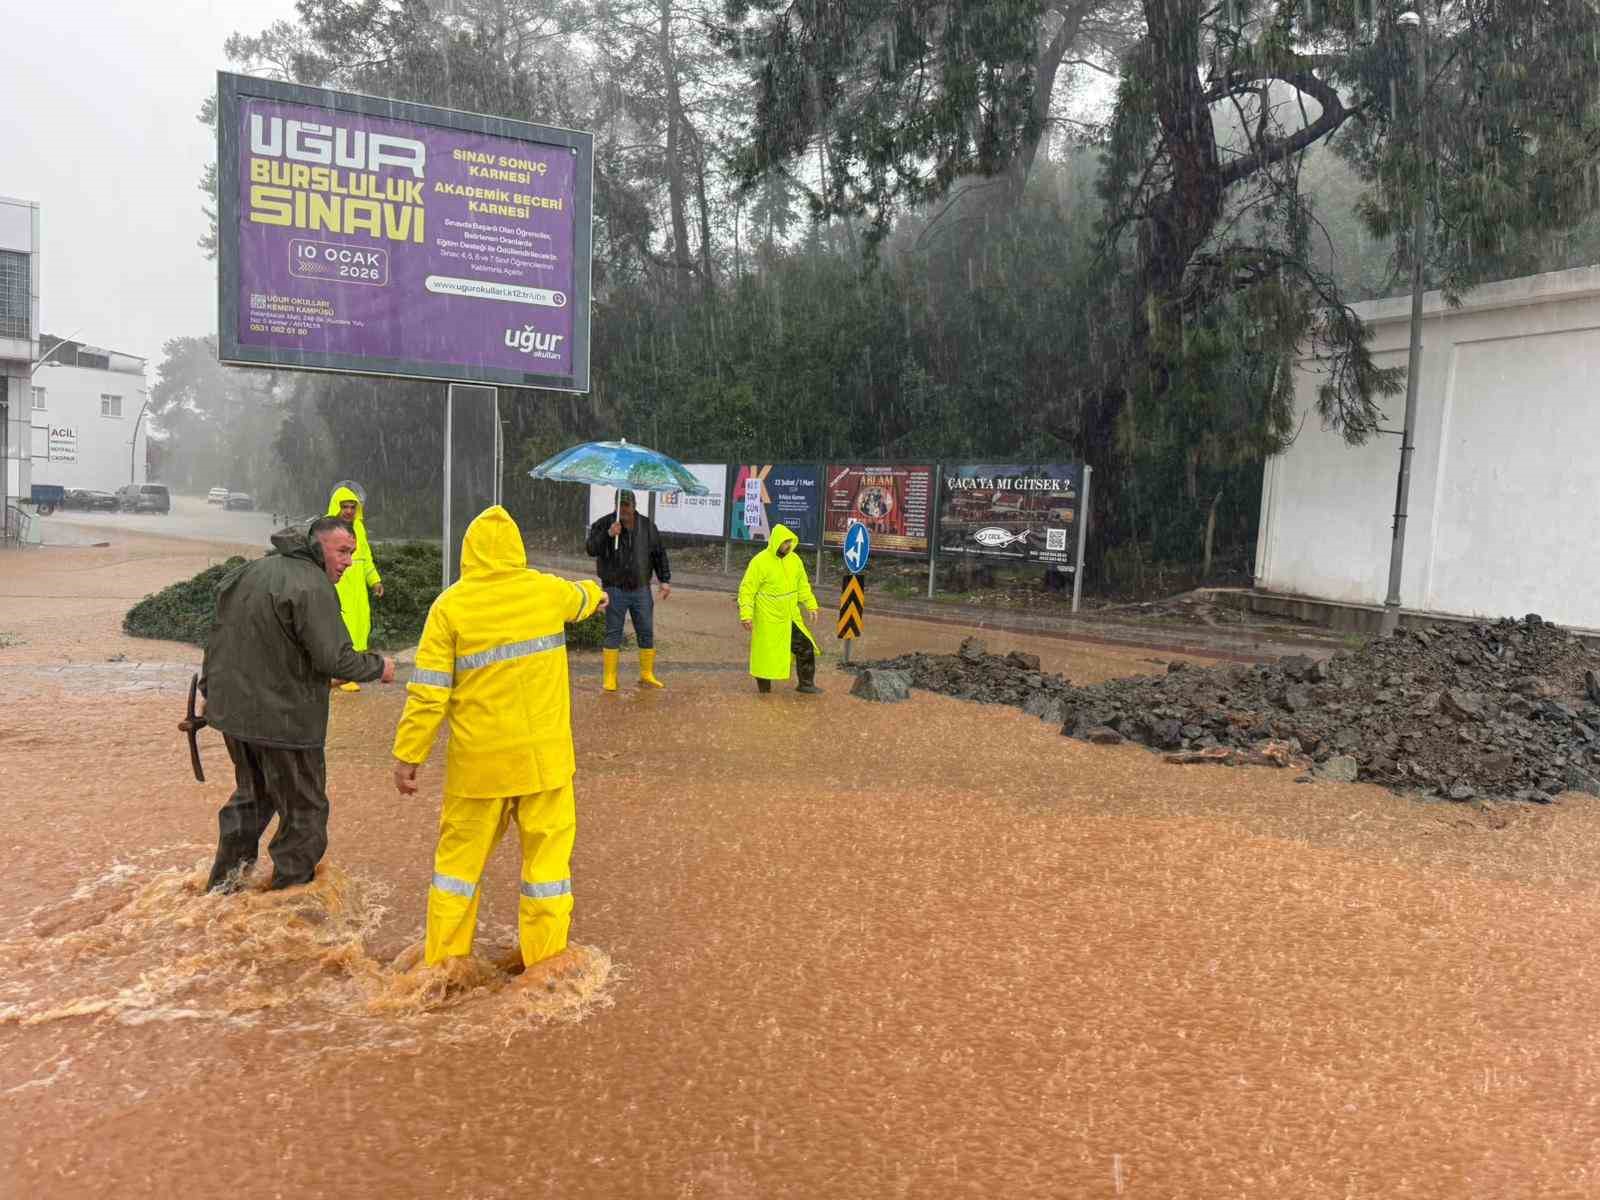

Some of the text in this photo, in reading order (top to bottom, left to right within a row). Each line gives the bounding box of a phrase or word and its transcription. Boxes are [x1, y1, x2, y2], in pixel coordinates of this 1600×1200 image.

[251, 114, 426, 178] UĞUR
[453, 149, 547, 176] SINAV SONUÇ
[251, 158, 424, 205] BURSLULUK
[469, 166, 531, 185] KARNESİ
[434, 182, 563, 210] AKADEMİK BECERİ
[250, 185, 425, 244] SINAVI
[468, 201, 530, 219] KARNESİ
[324, 248, 379, 266] OCAK
[340, 265, 379, 279] 2026
[291, 297, 330, 307] OKULLARI
[504, 324, 564, 352] uğur
[997, 478, 1011, 490] MI
[1014, 476, 1060, 490] GİTSEK
